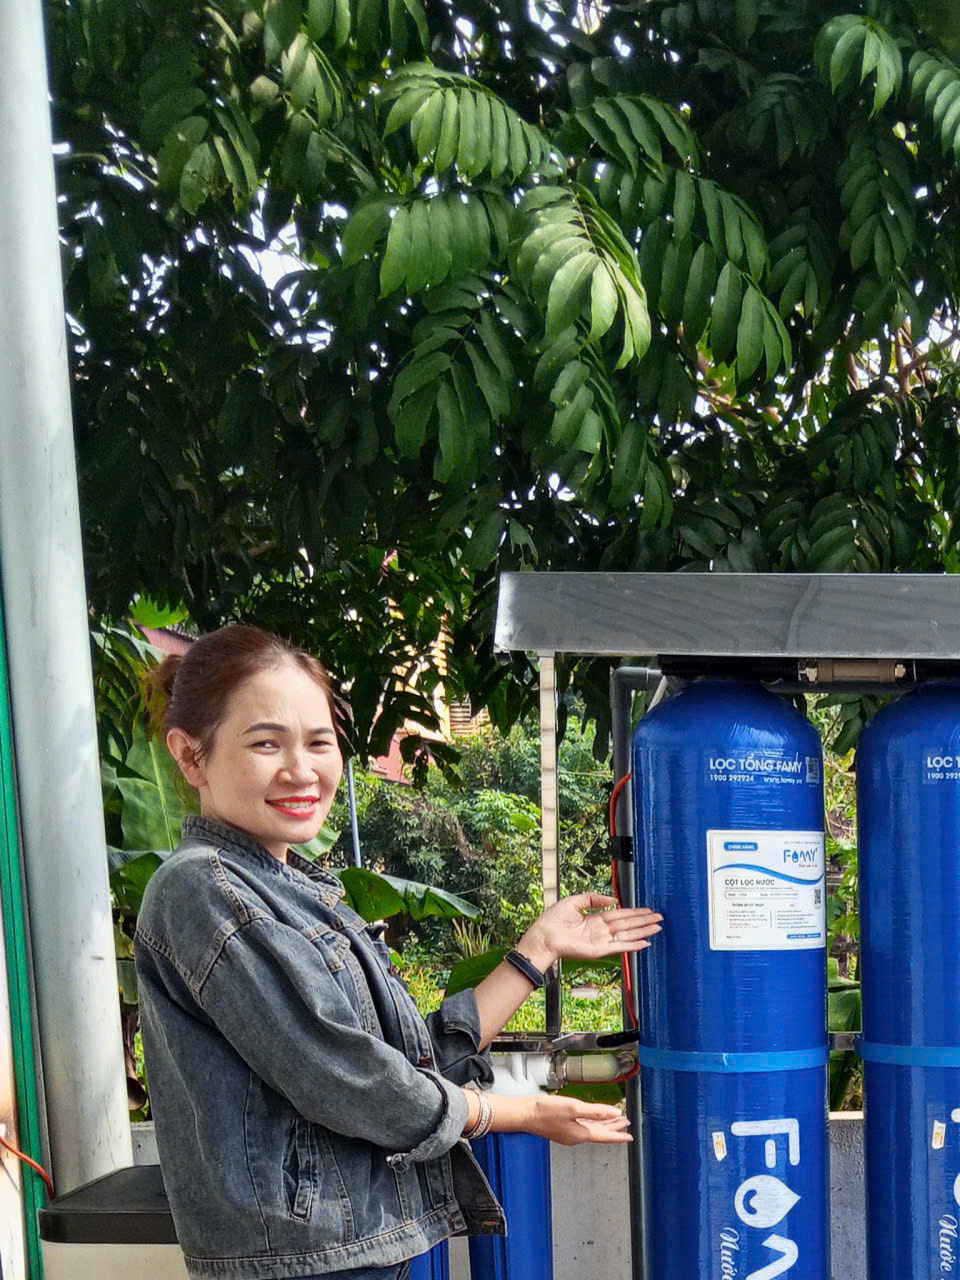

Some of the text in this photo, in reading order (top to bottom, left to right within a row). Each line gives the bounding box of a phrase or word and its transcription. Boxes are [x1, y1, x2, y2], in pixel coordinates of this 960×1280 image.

[709, 752, 802, 773] LỌC TỔNG FAMY
[927, 756, 953, 771] LỌC
[710, 774, 727, 782] 1900
[740, 878, 755, 887] LỌC
